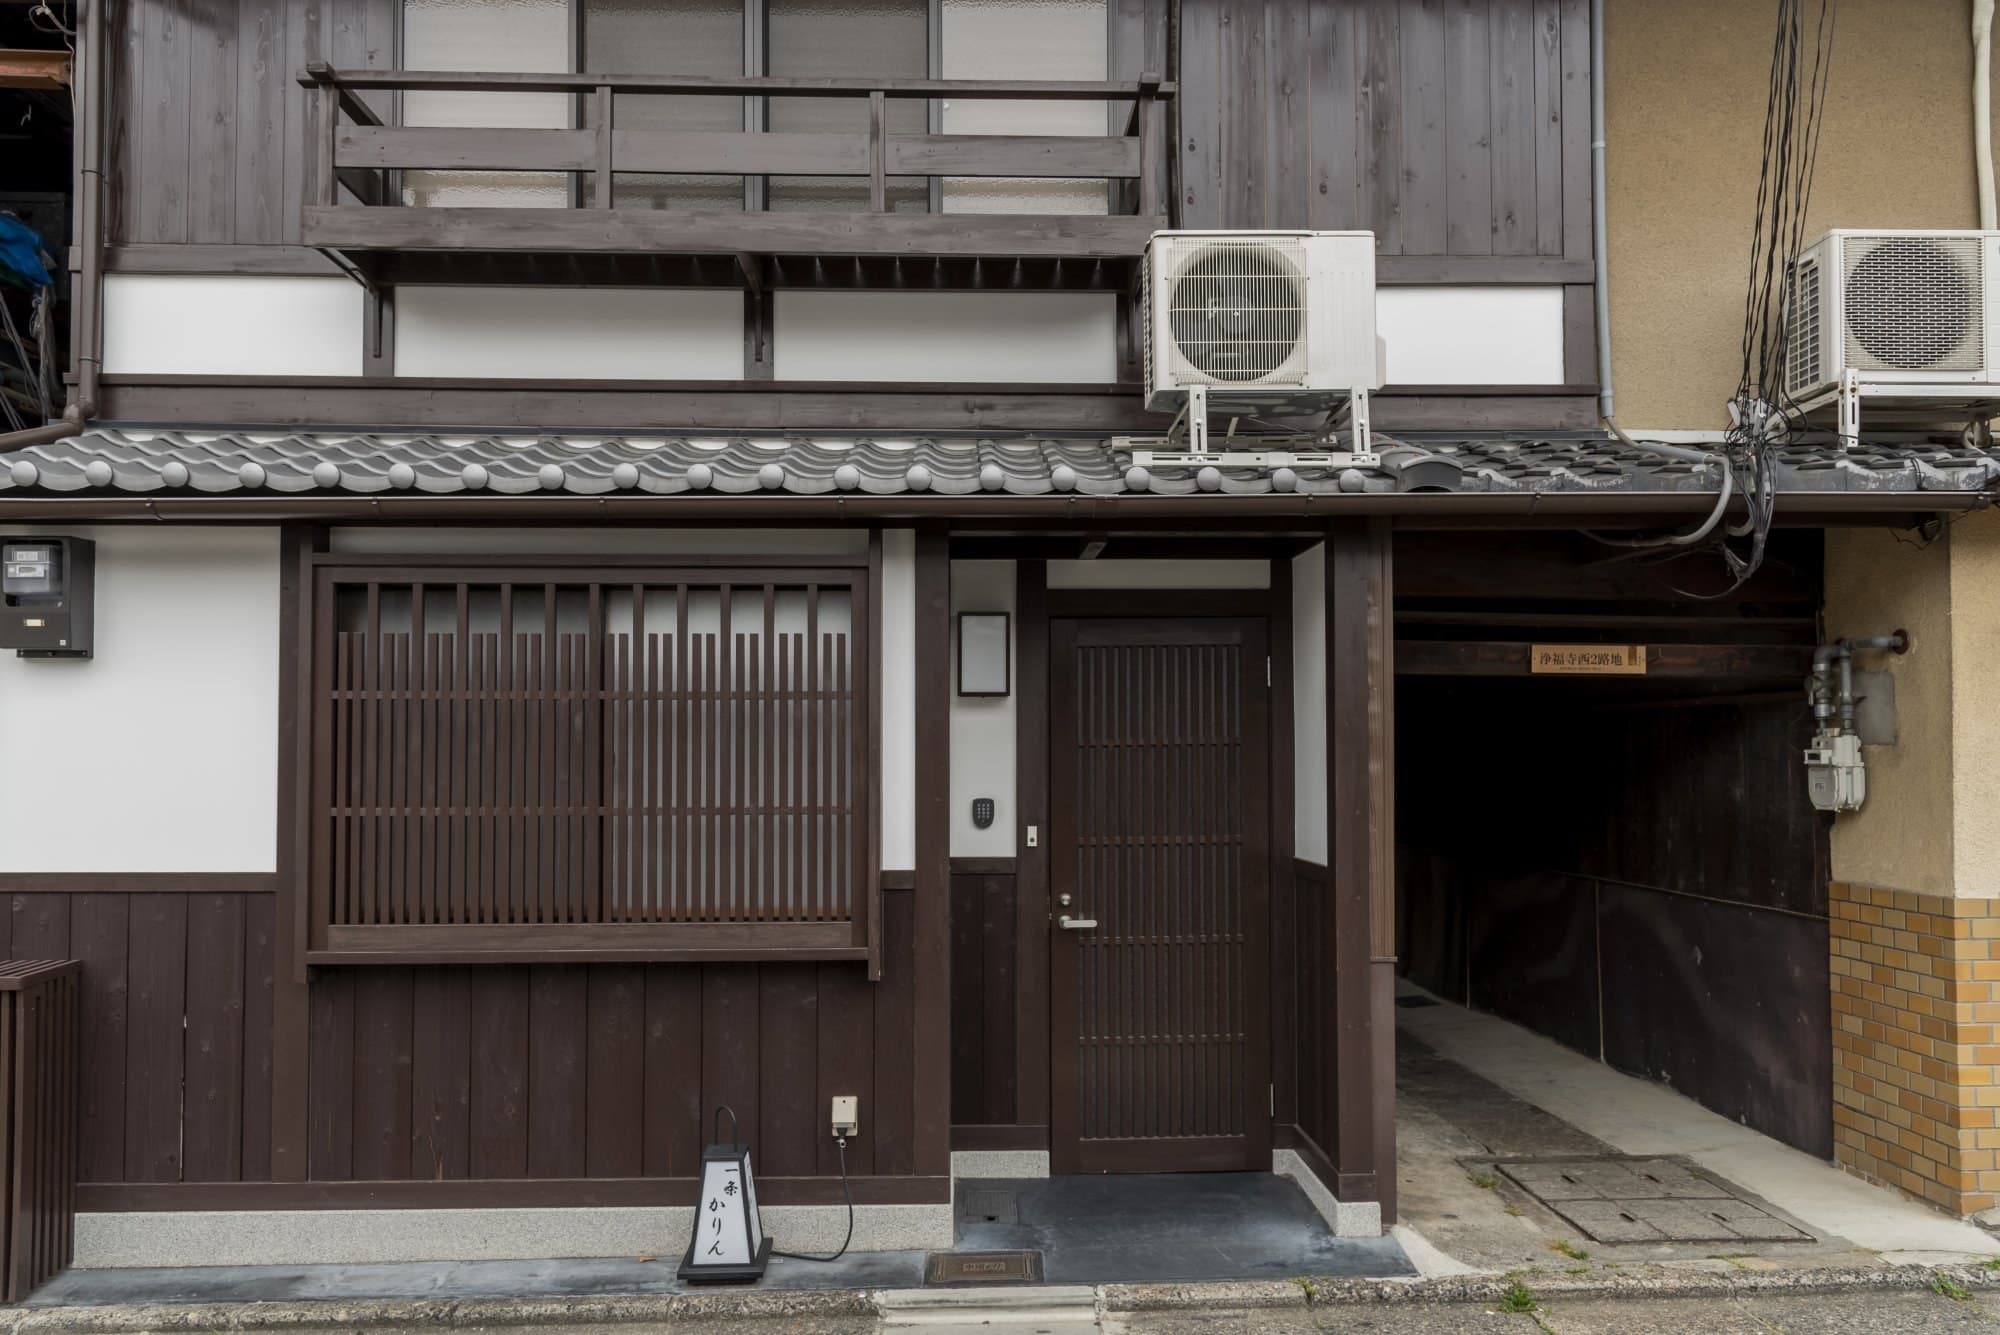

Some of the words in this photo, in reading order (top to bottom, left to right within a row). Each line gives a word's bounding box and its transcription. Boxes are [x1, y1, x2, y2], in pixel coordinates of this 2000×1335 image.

[724, 1168, 738, 1196] 一条
[708, 1197, 725, 1256] かりん
